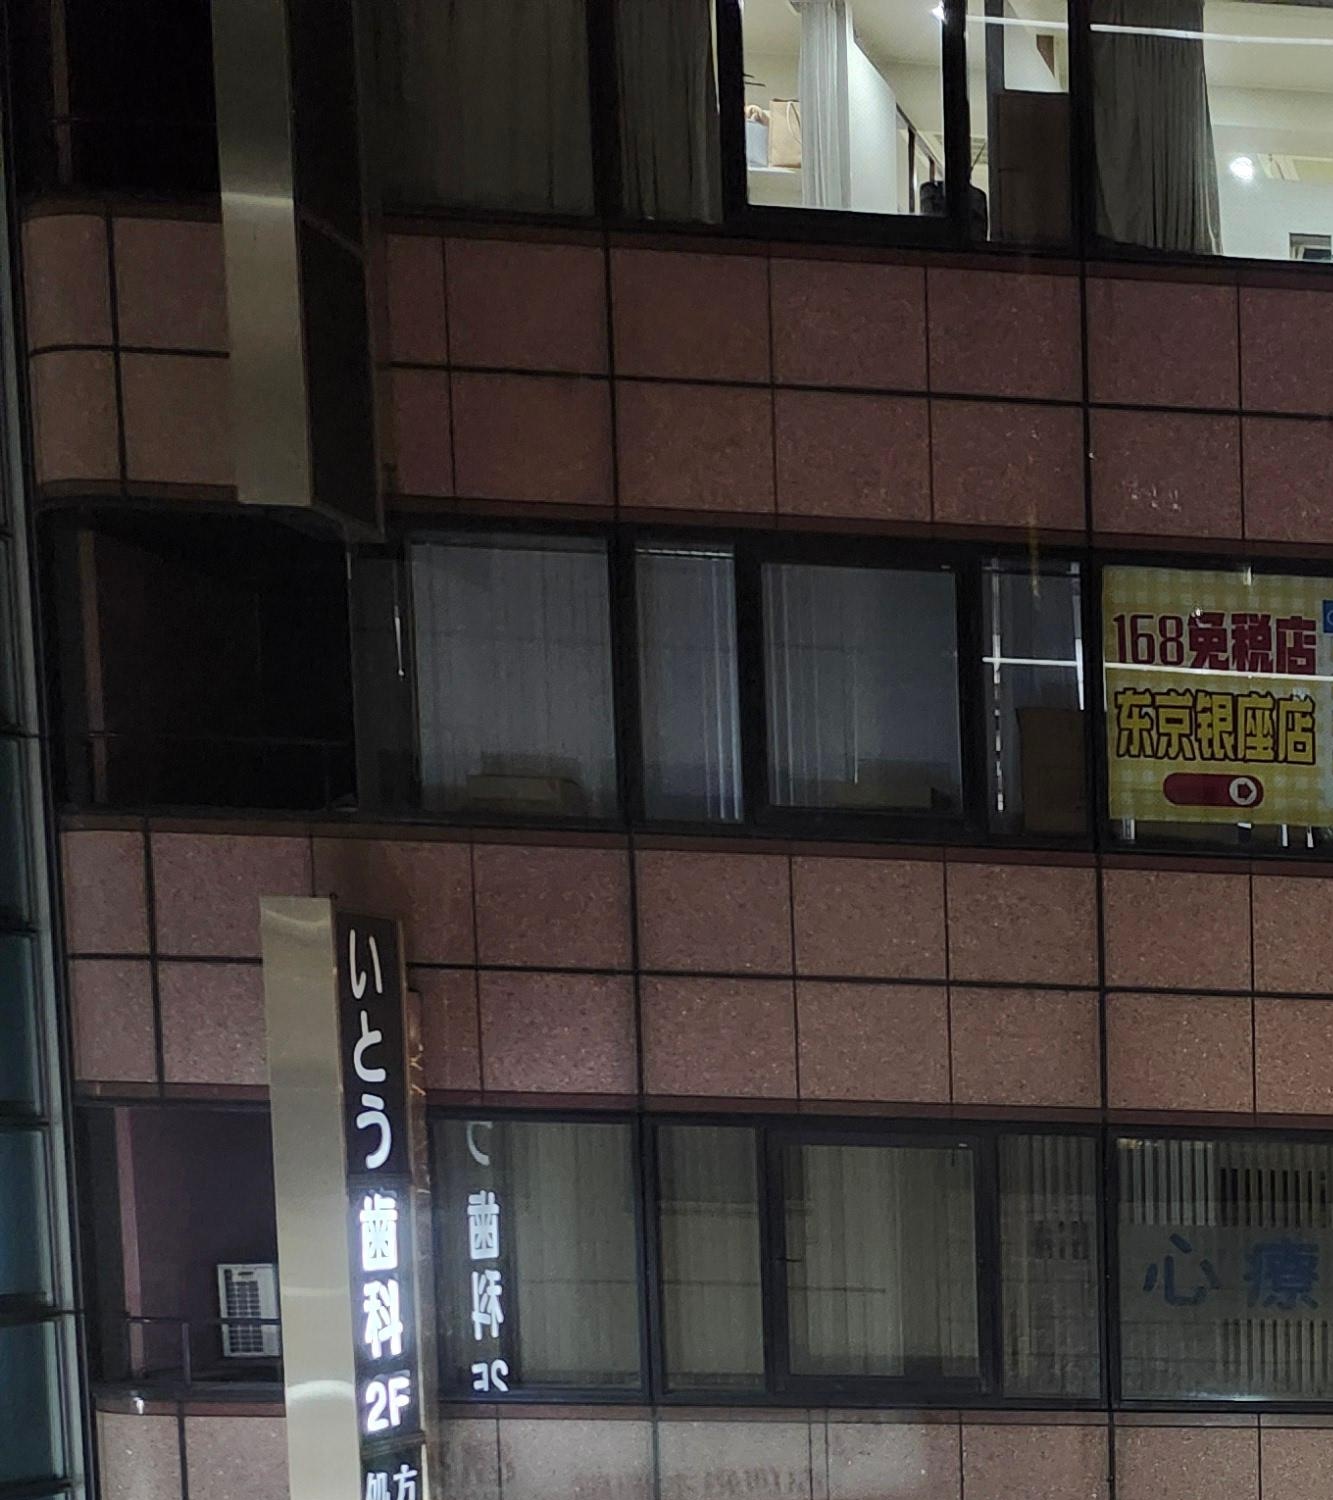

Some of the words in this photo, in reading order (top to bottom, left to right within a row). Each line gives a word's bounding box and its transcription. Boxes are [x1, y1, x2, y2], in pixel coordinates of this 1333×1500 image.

[1114, 612, 1317, 675] 168免税店
[1114, 688, 1316, 764] 东京银座店
[349, 928, 404, 1359] いとう歯科
[365, 1376, 411, 1432] 2F
